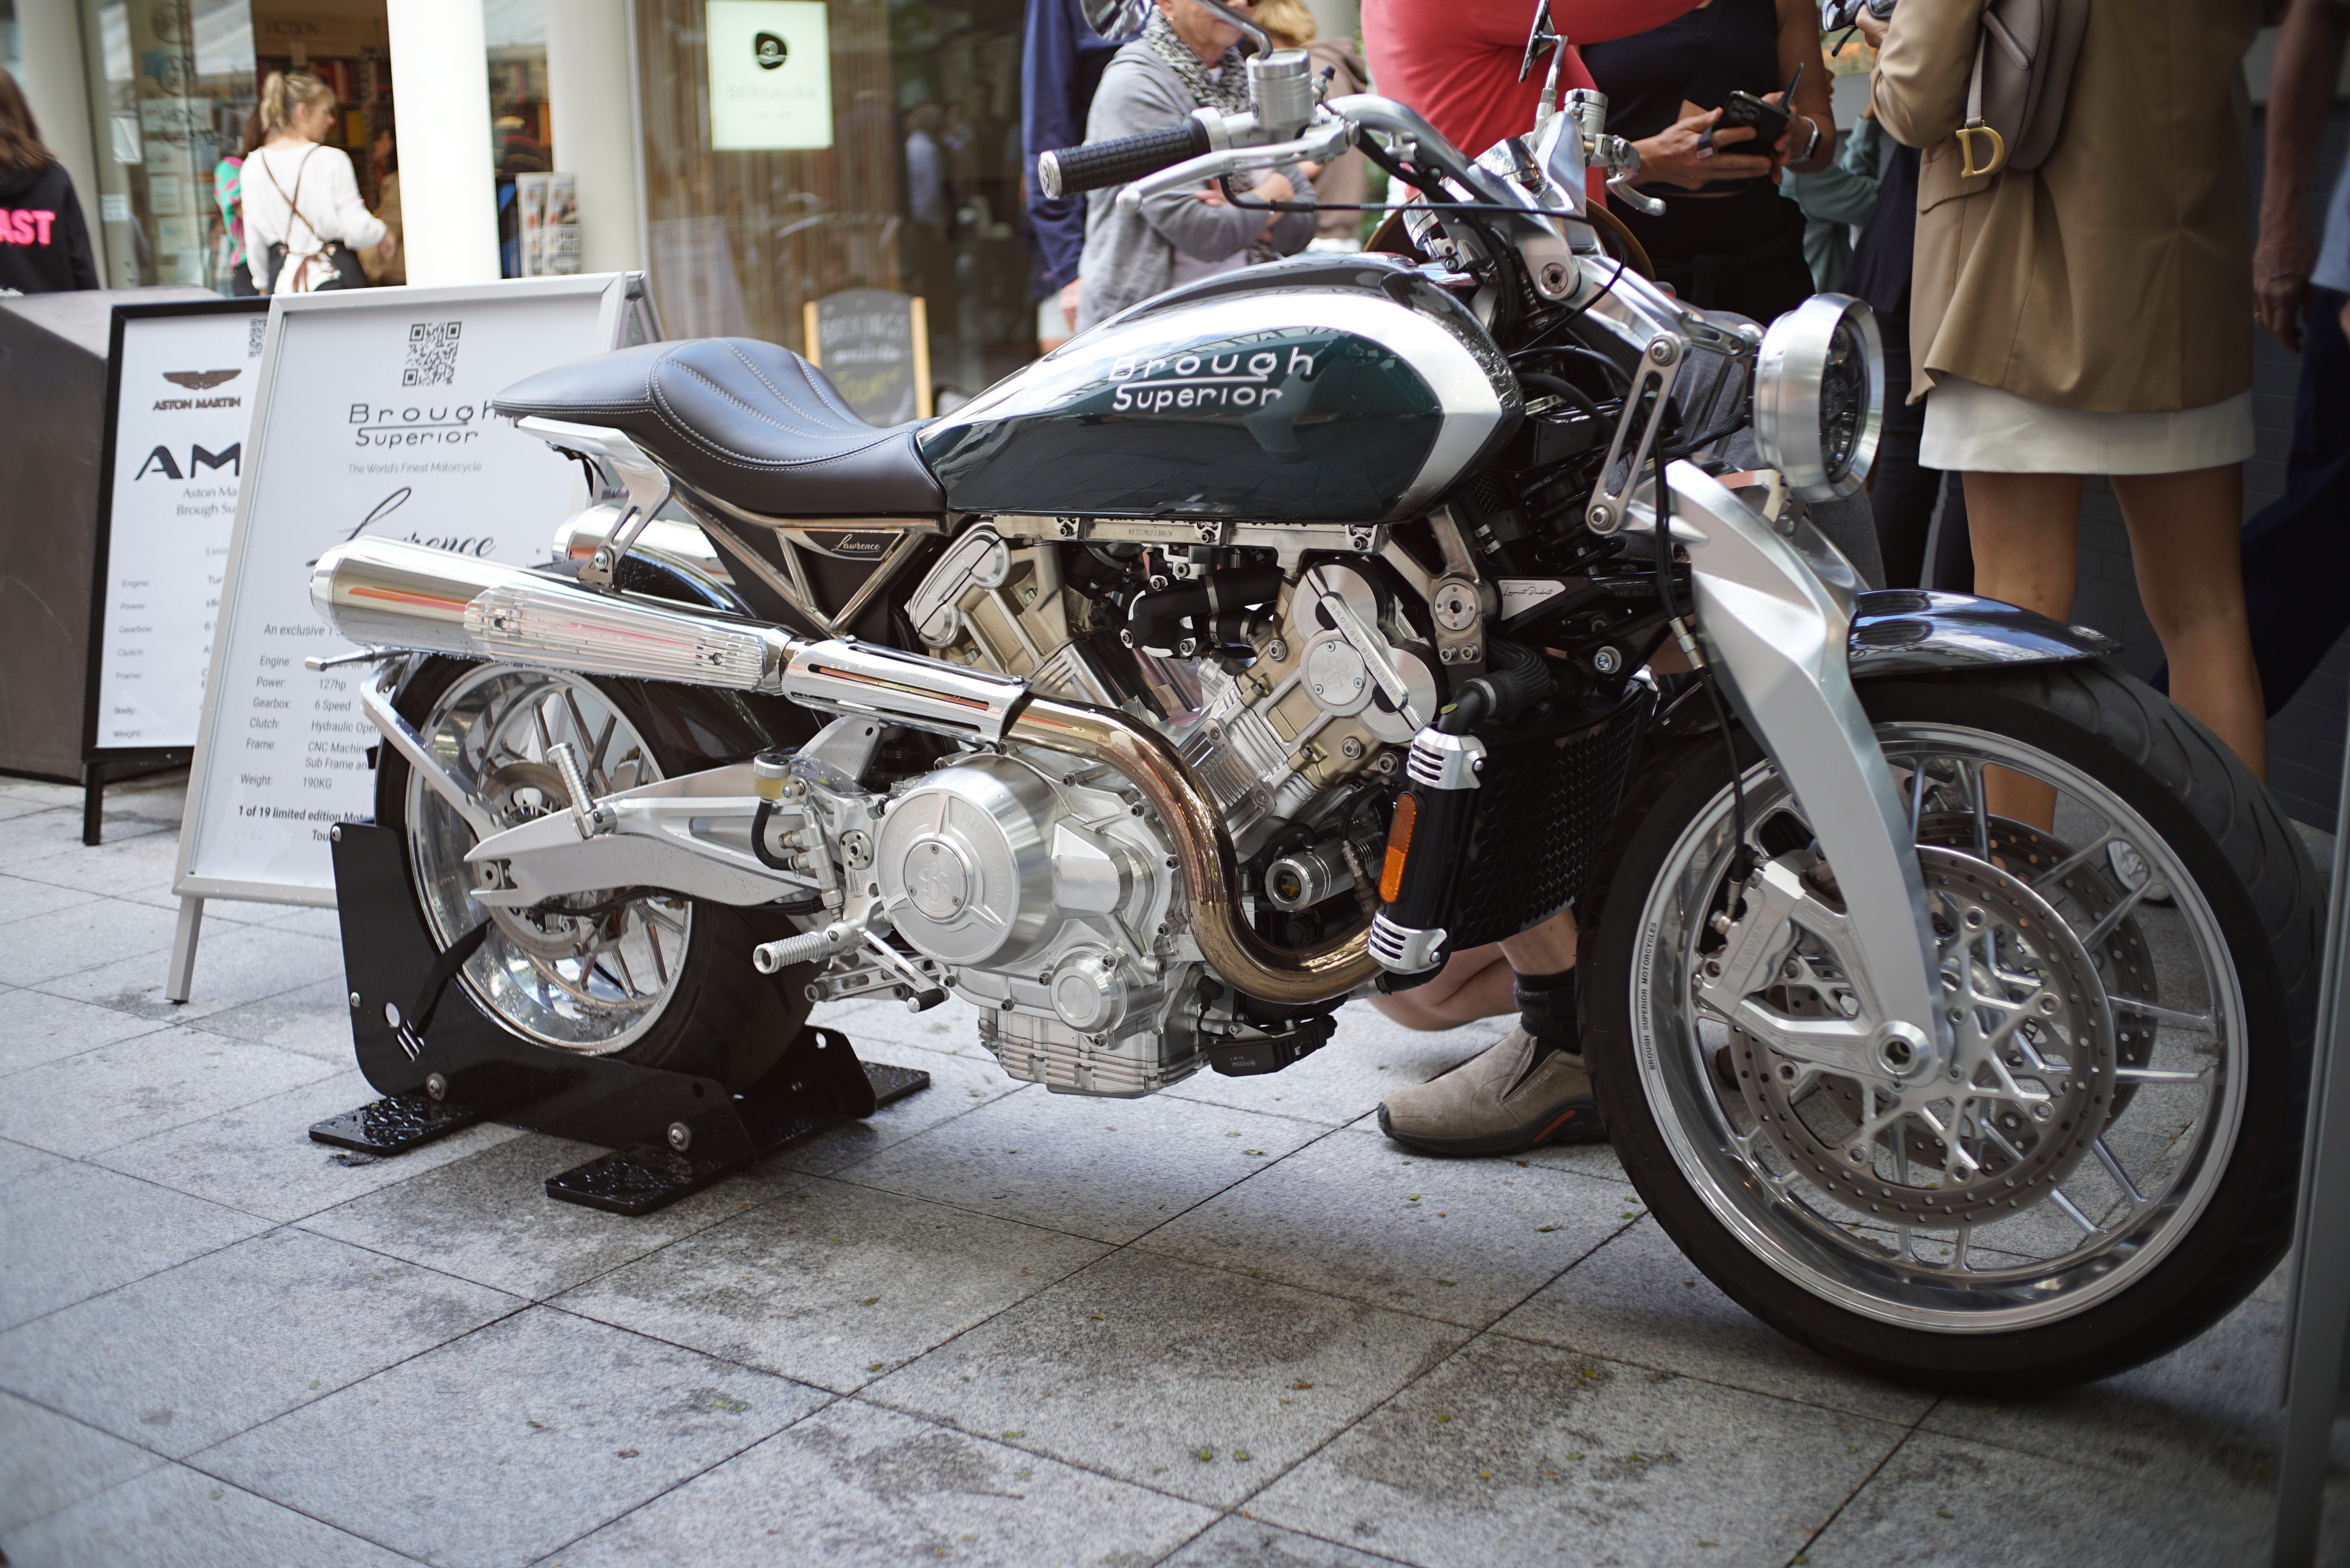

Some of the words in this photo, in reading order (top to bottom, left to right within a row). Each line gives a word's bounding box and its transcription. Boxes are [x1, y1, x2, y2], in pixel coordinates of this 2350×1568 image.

[1956, 126, 2004, 179] D
[1109, 347, 1314, 382] Brough
[153, 399, 192, 410] ASTON
[196, 397, 240, 408] MARTIN
[1113, 383, 1283, 413] Superior
[349, 400, 498, 425] Brough
[356, 427, 479, 449] Superior
[348, 463, 364, 474] The
[367, 462, 398, 474] World's
[401, 462, 428, 473] Finest
[431, 461, 482, 475] Motorcycle
[183, 487, 216, 498] Aston
[176, 503, 218, 518] Brough
[831, 533, 881, 552] Lawrence
[264, 623, 276, 635] An
[280, 623, 324, 636] exclusive
[1331, 604, 1360, 643] BROUGH
[1362, 648, 1397, 696] SUPERIOR
[260, 655, 291, 668] Engine:
[256, 676, 286, 688] Power:
[319, 678, 346, 693] 127hp
[253, 697, 291, 709] Gearbox:
[315, 699, 320, 710] 6
[323, 700, 351, 712] Speed
[250, 718, 280, 729] Clutch:
[311, 720, 353, 733] Hydraulic
[246, 738, 276, 750] Frame:
[308, 741, 328, 752] CNC
[305, 757, 322, 768] Sub
[325, 758, 353, 769] Frame
[241, 774, 273, 787] Weight:
[303, 777, 332, 789] 190KG
[239, 805, 243, 817] 1
[246, 805, 257, 817] of
[260, 807, 270, 818] 19
[273, 807, 306, 820] limited
[308, 810, 341, 823] edition
[887, 803, 929, 879] BROUGH
[960, 813, 1006, 905] SUPERIOR
[1642, 922, 1657, 984] MOTORCYCLES
[1643, 1035, 1656, 1070] BROUGH
